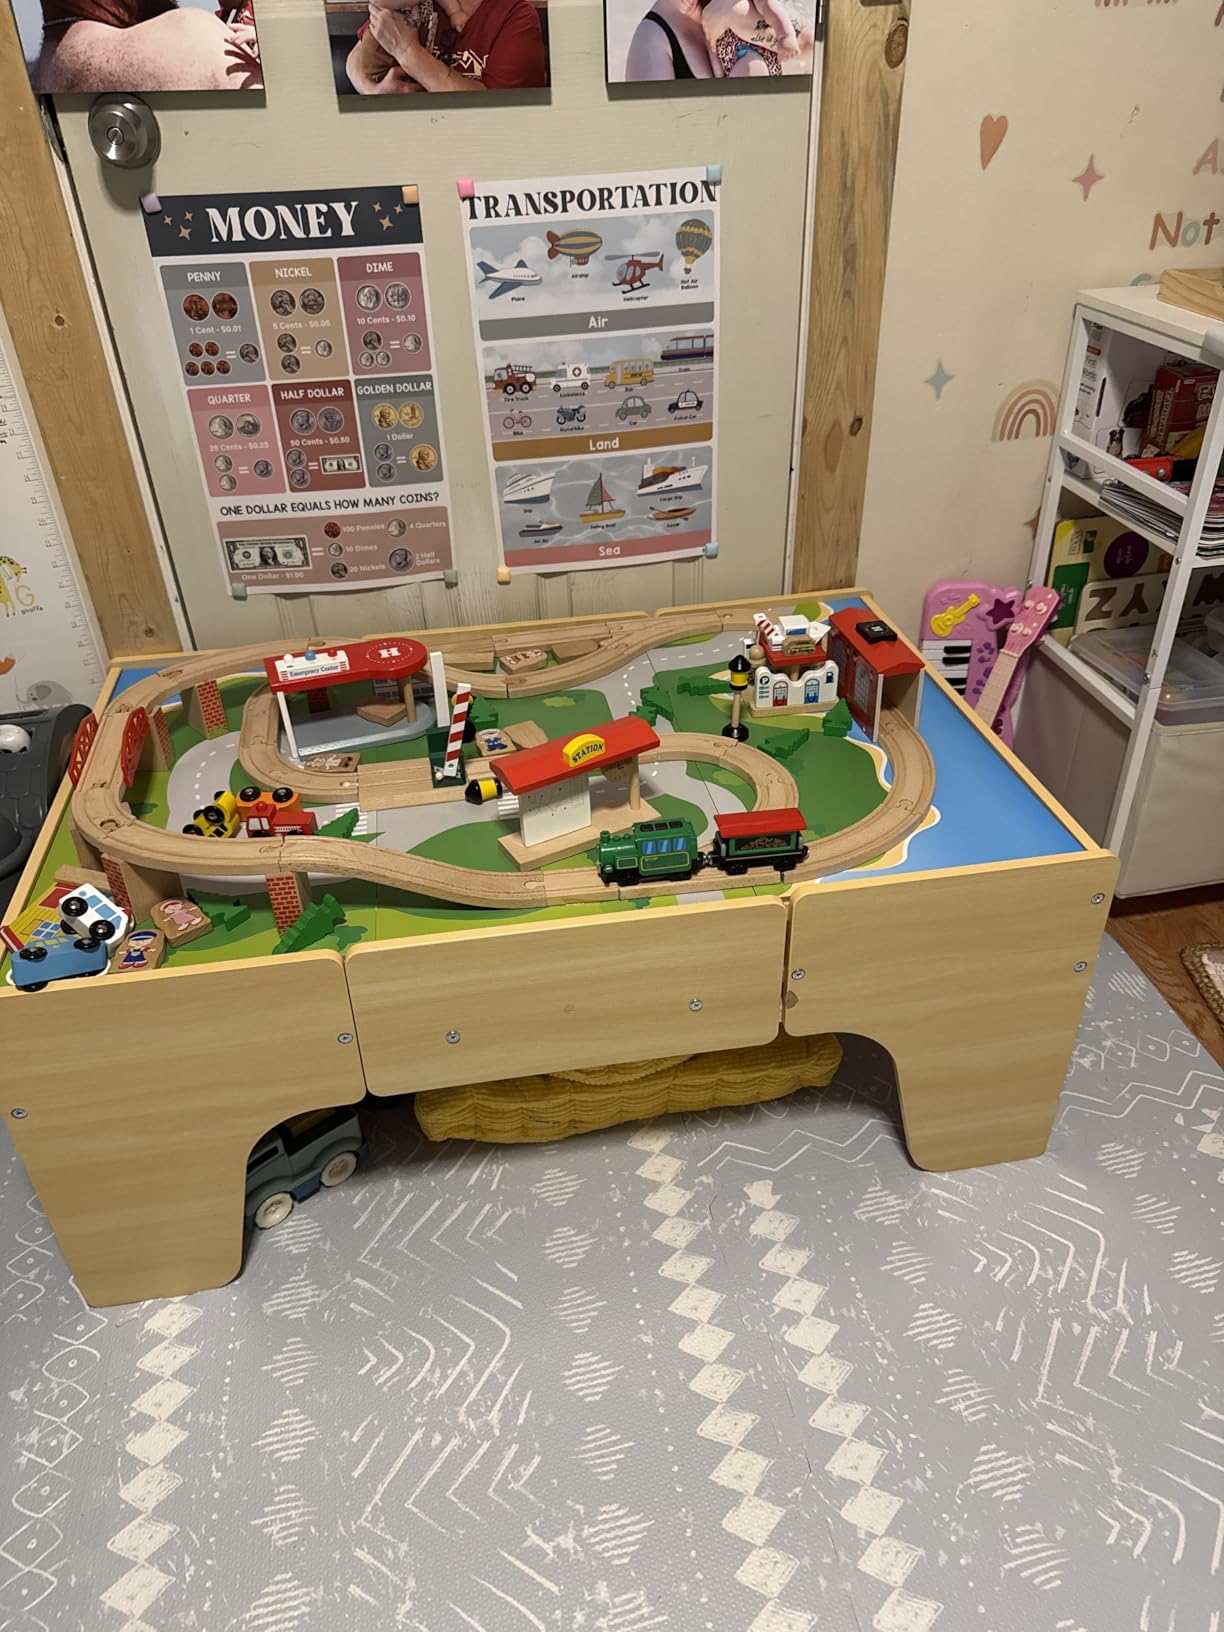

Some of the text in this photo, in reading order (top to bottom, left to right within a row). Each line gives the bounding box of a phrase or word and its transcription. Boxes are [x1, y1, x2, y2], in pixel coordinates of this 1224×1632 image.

[1193, 138, 1224, 176] A
[462, 180, 718, 220] TRANSPORTATION
[205, 201, 359, 243] MONEY
[1149, 211, 1221, 251] Not
[275, 266, 312, 278] NICKEL
[366, 261, 394, 274] DIME
[187, 271, 222, 283] PENNY
[272, 322, 278, 330] 5
[280, 320, 303, 329] Cents
[309, 320, 331, 328] $0.05
[356, 316, 365, 324] 10
[366, 316, 390, 324] Cents
[396, 314, 416, 323] $0.10
[588, 315, 608, 329] Air
[195, 326, 214, 335] Cent
[221, 325, 242, 334] $0.01
[280, 387, 344, 400] HALF DOLLAR
[356, 381, 433, 396] GOLDEN DOLLAR
[207, 393, 252, 405] QUARTER
[302, 438, 324, 446] Cents
[329, 436, 350, 445] $0.50
[392, 432, 414, 440] Dollar
[209, 444, 220, 452] 25
[222, 442, 242, 451] Cents
[248, 441, 270, 450] $0.25
[589, 438, 620, 451] Land
[220, 492, 440, 516] ONE DOLLAR EQUALS HOW MANY COINS?
[342, 523, 385, 534] 100 Pennies
[409, 520, 446, 530] 4 Quarters
[345, 544, 378, 553] 10 Dimes
[599, 546, 621, 557] Sea
[416, 556, 440, 566] Dollars
[421, 551, 435, 559] Half
[350, 562, 386, 574] 20 Nickels
[258, 572, 280, 580] Dollar
[285, 571, 304, 579] $1.00
[16, 584, 35, 606] G
[1119, 582, 1148, 618] Y
[1085, 587, 1118, 622] Z
[378, 647, 400, 659] H
[290, 664, 339, 678] Emergency Center
[572, 744, 604, 763] STATION
